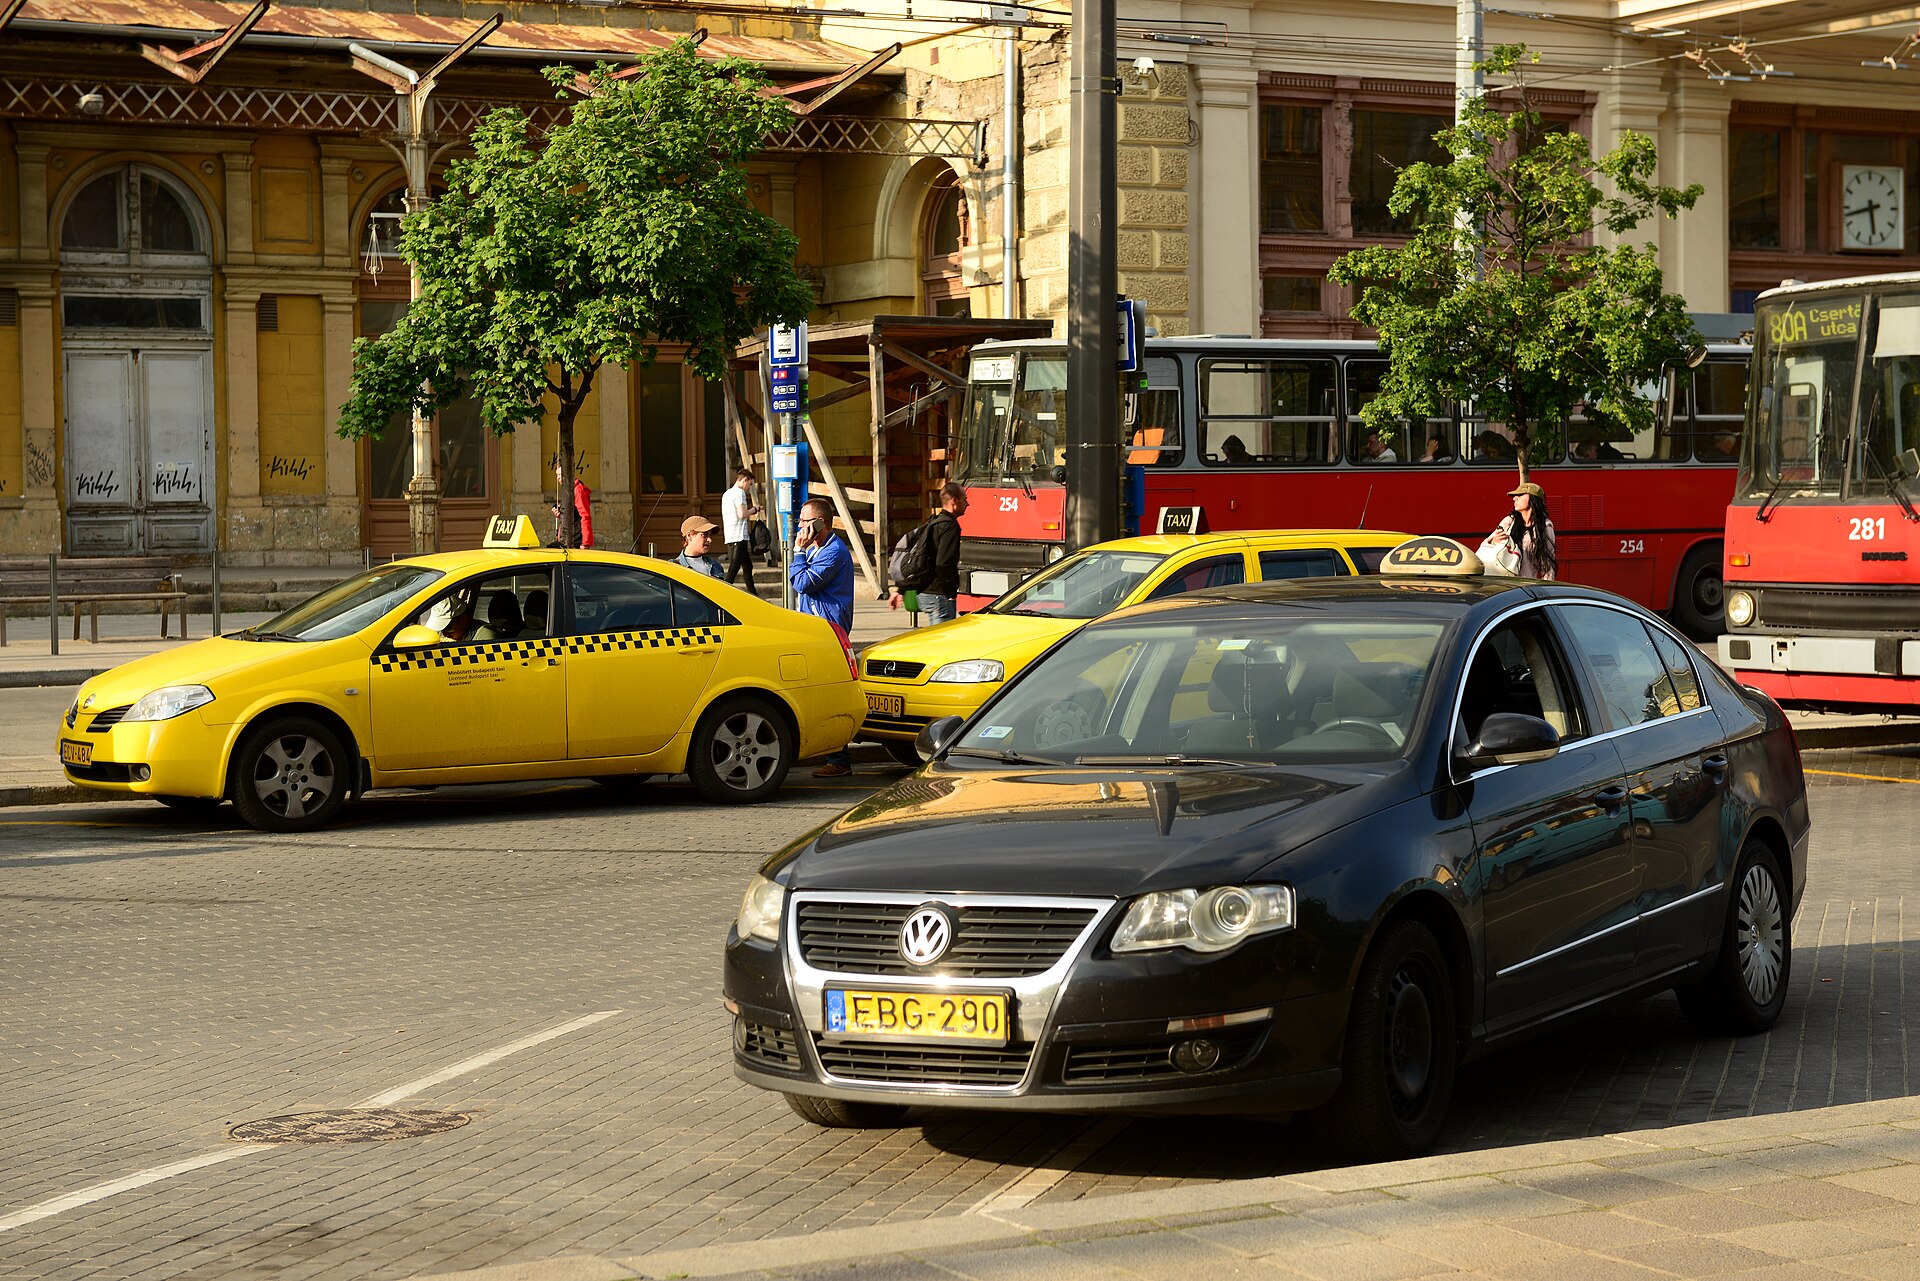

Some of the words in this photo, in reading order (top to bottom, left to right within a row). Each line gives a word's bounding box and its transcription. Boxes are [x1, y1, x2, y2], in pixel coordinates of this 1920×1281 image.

[1770, 310, 1808, 343] 80A
[1820, 321, 1857, 336] utca
[991, 363, 1002, 378] 76
[999, 496, 1019, 512] 254
[495, 519, 516, 534] TAXI
[1166, 514, 1191, 527] TAXI
[1848, 517, 1885, 540] 281
[1395, 546, 1460, 563] TAXI
[1620, 540, 1644, 553] 254
[866, 695, 900, 713] CU-016
[64, 744, 91, 763] ECV-484
[852, 993, 999, 1034] EBG-290
